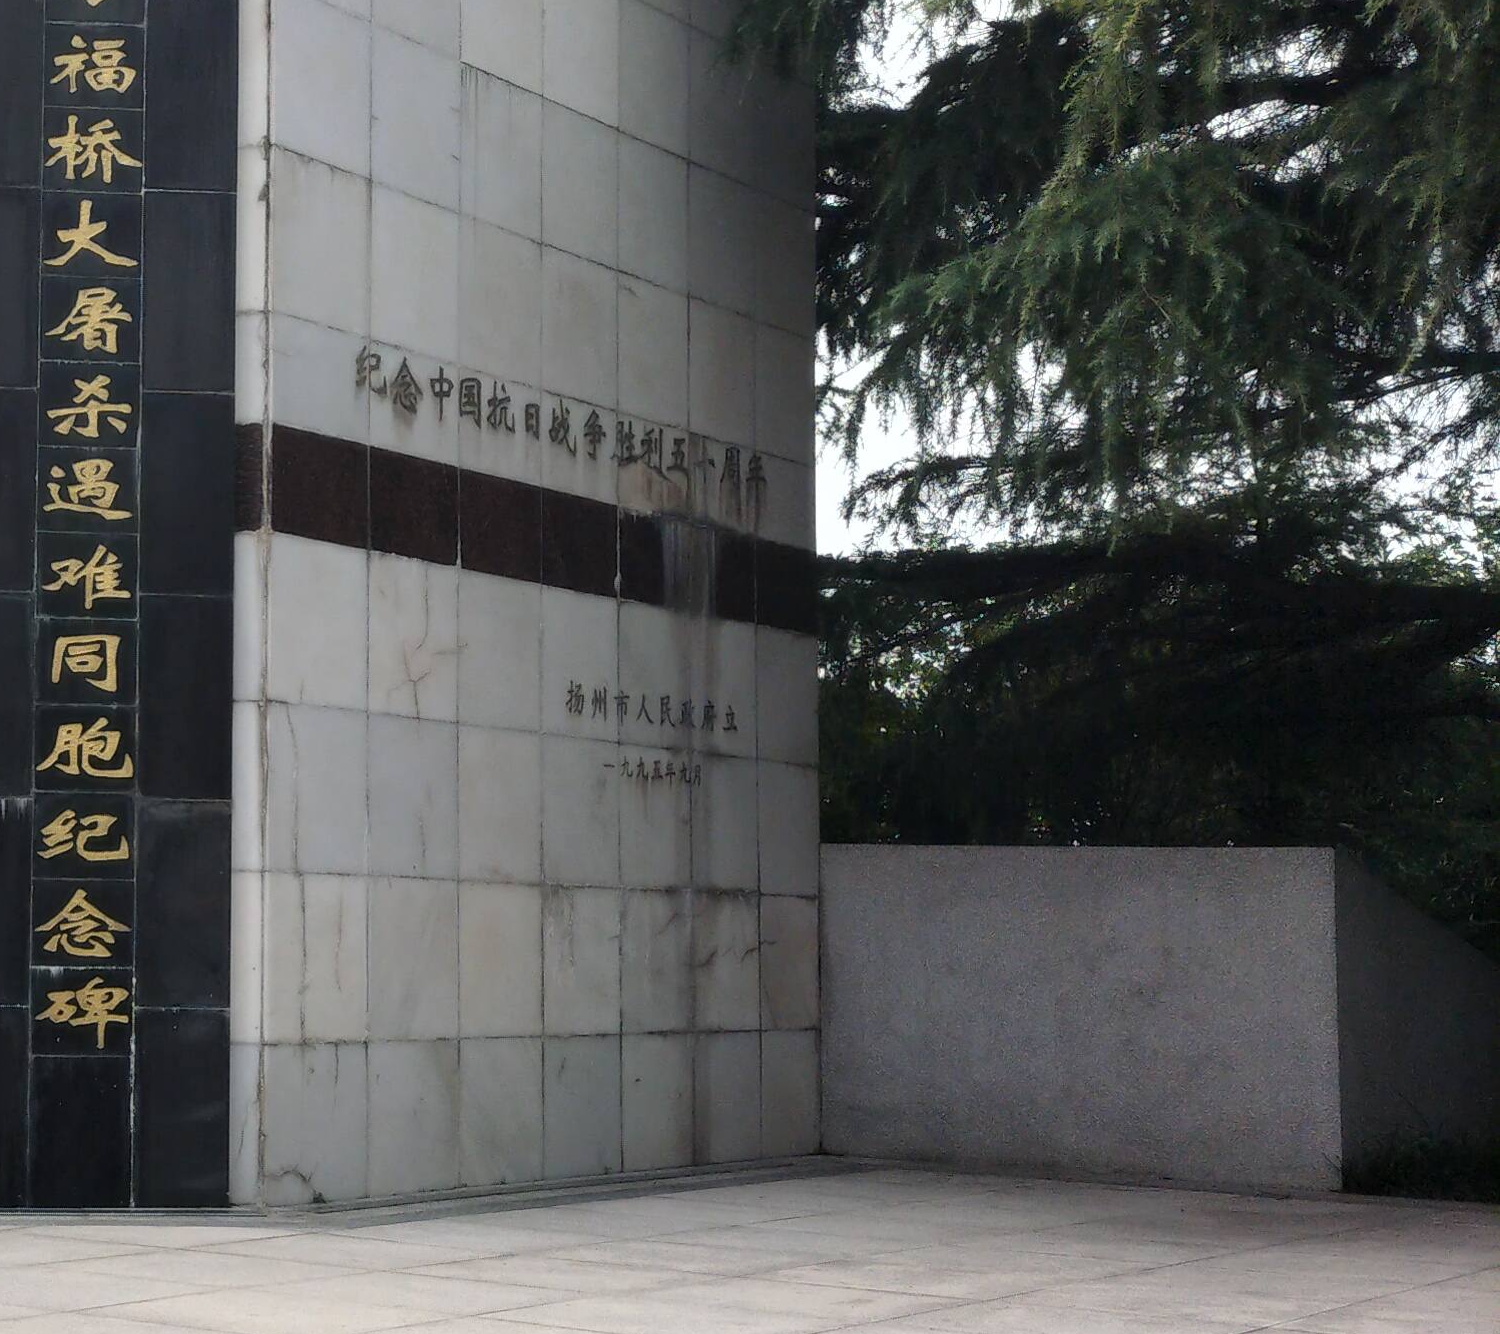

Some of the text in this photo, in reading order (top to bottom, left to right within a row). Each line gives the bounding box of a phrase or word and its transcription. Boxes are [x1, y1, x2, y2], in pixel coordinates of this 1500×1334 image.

[354, 344, 768, 493] 纪念中国抗日战争胜利五十周年
[564, 679, 739, 734] 扬州市人民政府立
[603, 755, 702, 788] 一九九五年九月
